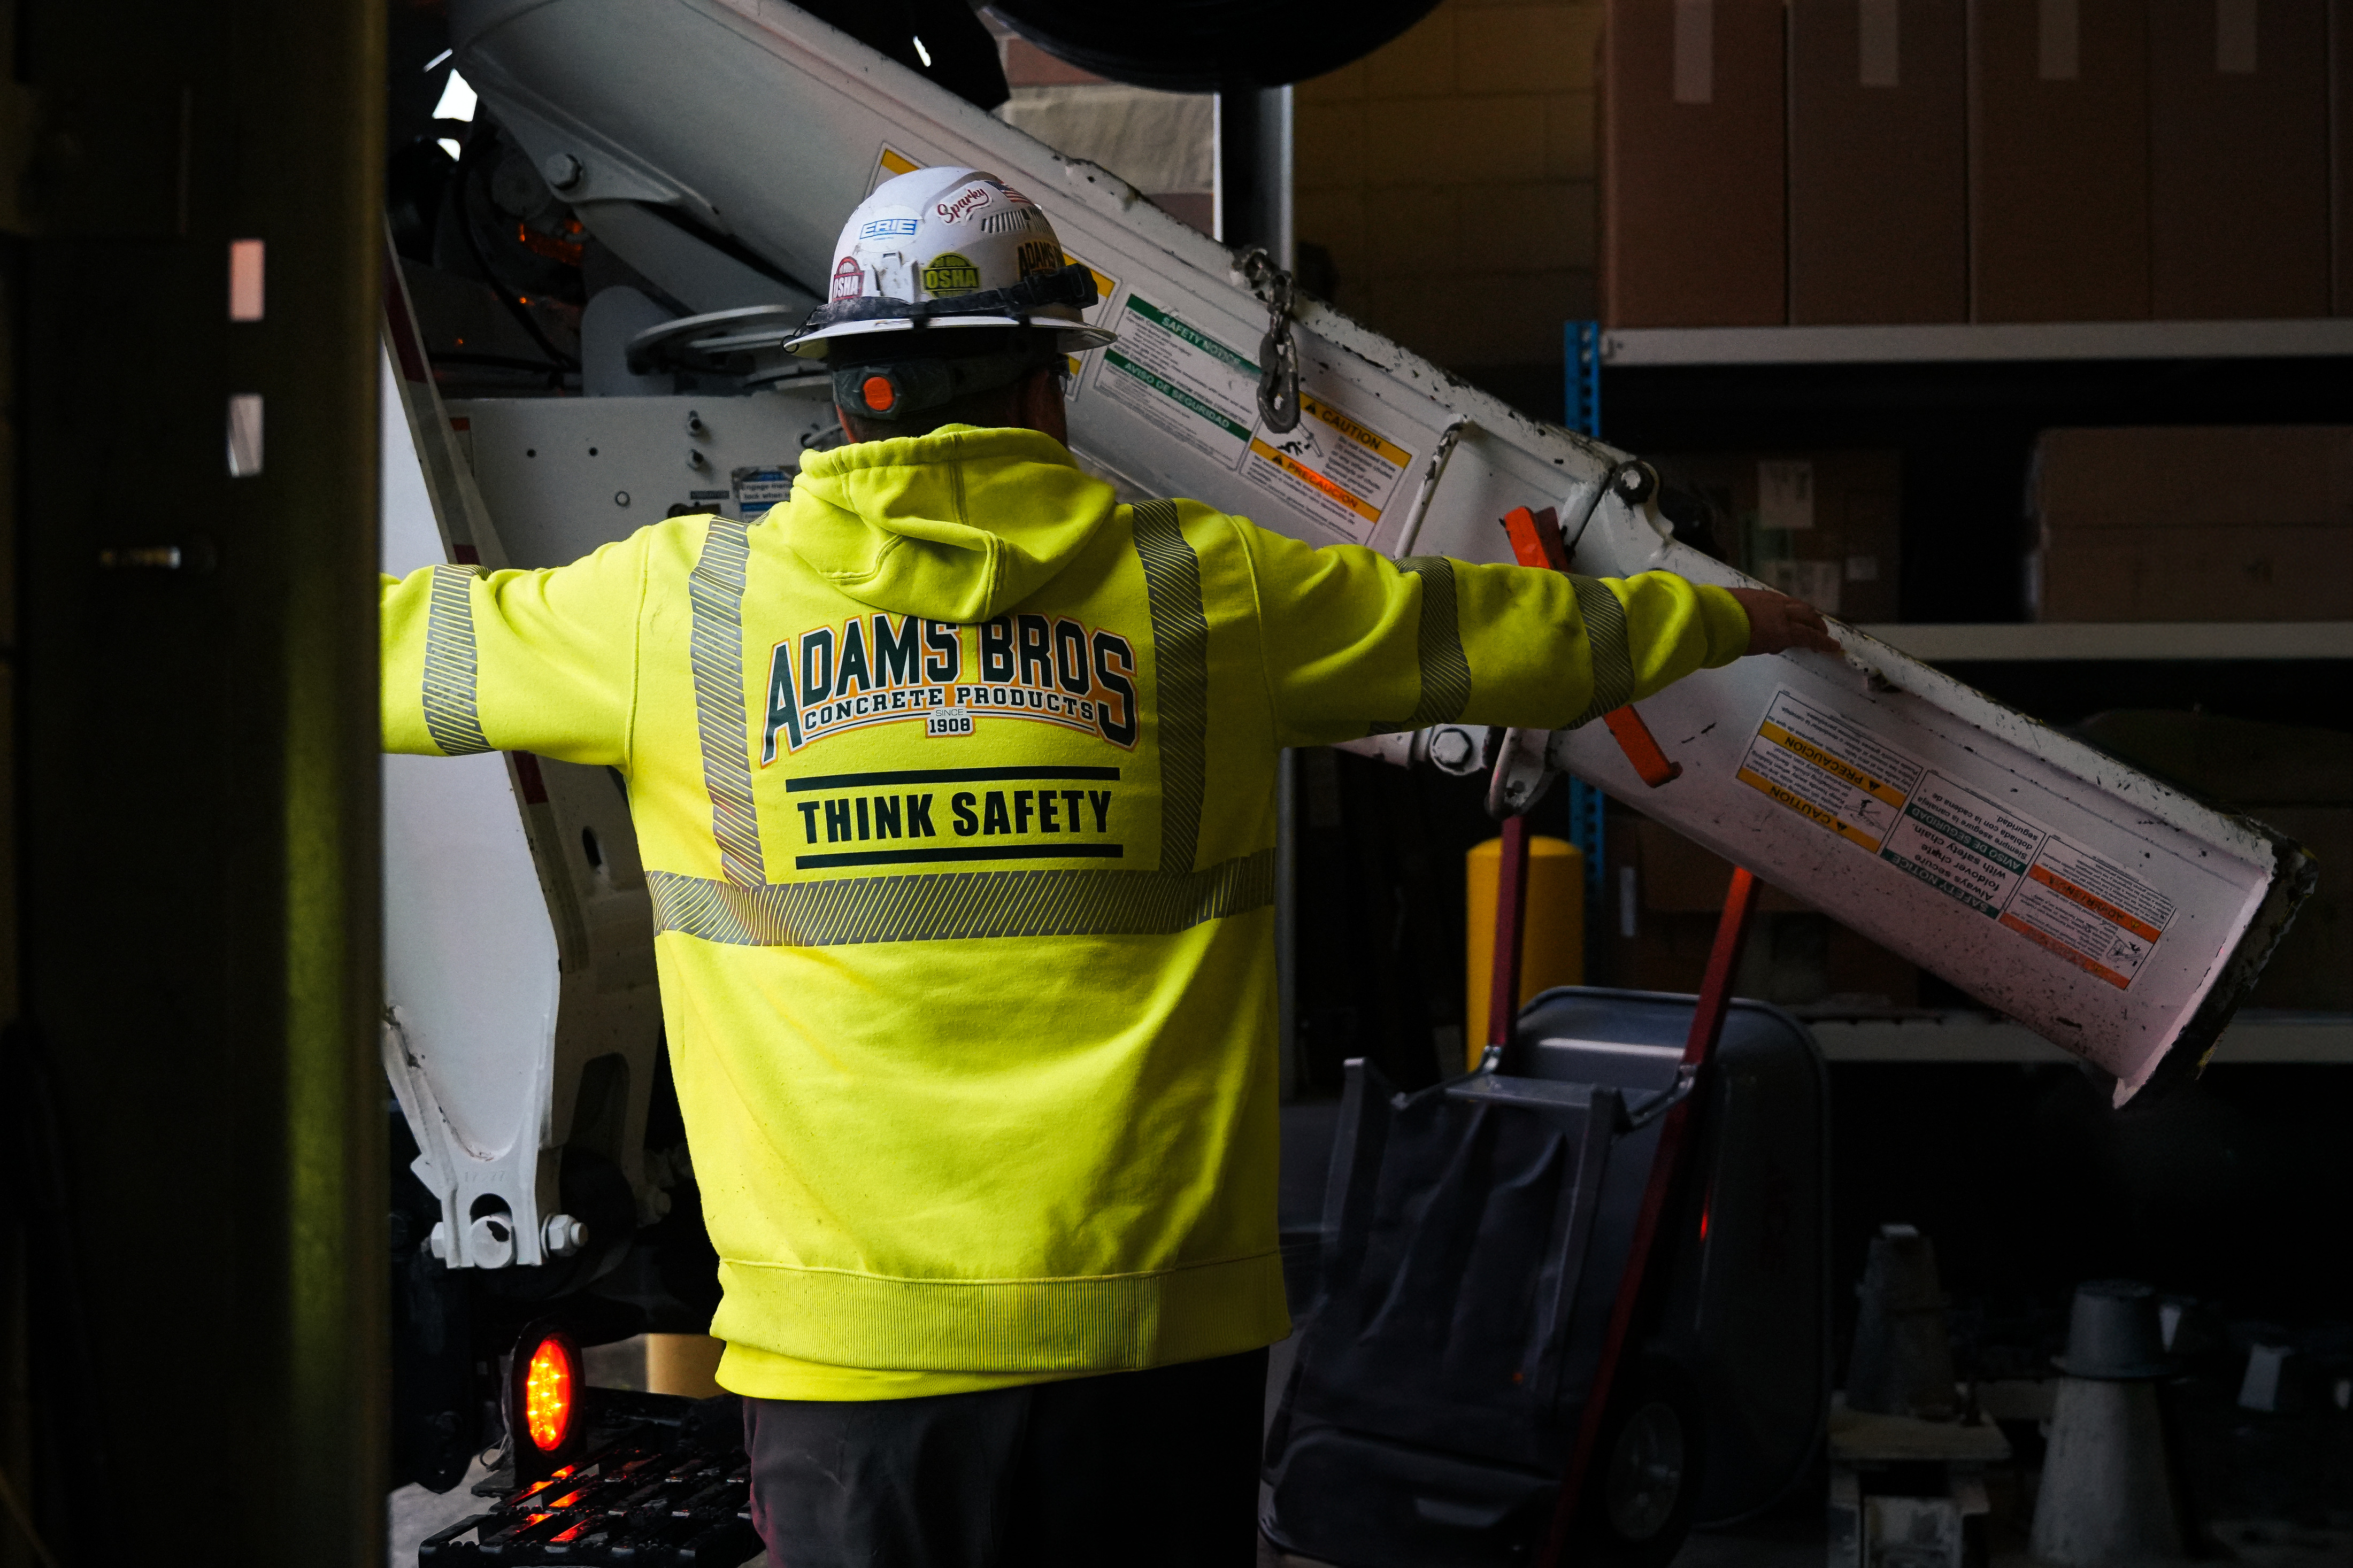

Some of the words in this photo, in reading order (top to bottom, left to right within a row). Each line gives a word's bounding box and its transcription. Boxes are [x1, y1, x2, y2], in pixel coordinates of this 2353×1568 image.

[937, 188, 989, 223] Sparky
[860, 220, 917, 239] ERIE
[834, 276, 859, 297] OSHA
[926, 269, 978, 288] OSHA
[1124, 361, 1155, 384] AVISO
[1155, 380, 1171, 393] DE
[1170, 389, 1232, 428] SEGURIDAD
[1320, 410, 1382, 450] CAUTION
[763, 613, 960, 767] ADAMS
[979, 614, 1137, 748] BROS
[805, 688, 943, 730] CONCRETE
[957, 688, 1094, 720] PRODUCTS
[935, 708, 963, 717] SINCE
[929, 717, 970, 733] 1908
[1783, 736, 1864, 784] PRECAUCION
[1768, 785, 1832, 824] CAUTION
[1917, 795, 1951, 817] canaleja
[1931, 792, 1943, 802] de
[1943, 799, 1973, 818] cadena
[797, 794, 936, 844] THINK
[952, 790, 1112, 836] SAFETY
[1910, 806, 1972, 844] SEGURIDAD
[1950, 814, 1959, 822] la
[1960, 818, 1993, 840] asegure
[1973, 815, 1982, 823] la
[1983, 820, 1999, 831] con
[1994, 814, 2038, 842] seguridad.
[1910, 823, 1944, 847] chain.
[1972, 840, 1988, 852] DE
[1999, 829, 2033, 851] doblada
[1944, 841, 1981, 867] safety
[1988, 848, 2020, 870] AVISO
[1993, 836, 2028, 860] Siempre
[1889, 853, 1939, 885] NOTICE
[1913, 854, 1951, 878] secure
[1952, 861, 2000, 892] foldover
[1981, 862, 2006, 880] with
[1937, 878, 1990, 912] SAFETY
[1952, 874, 1994, 902] Always
